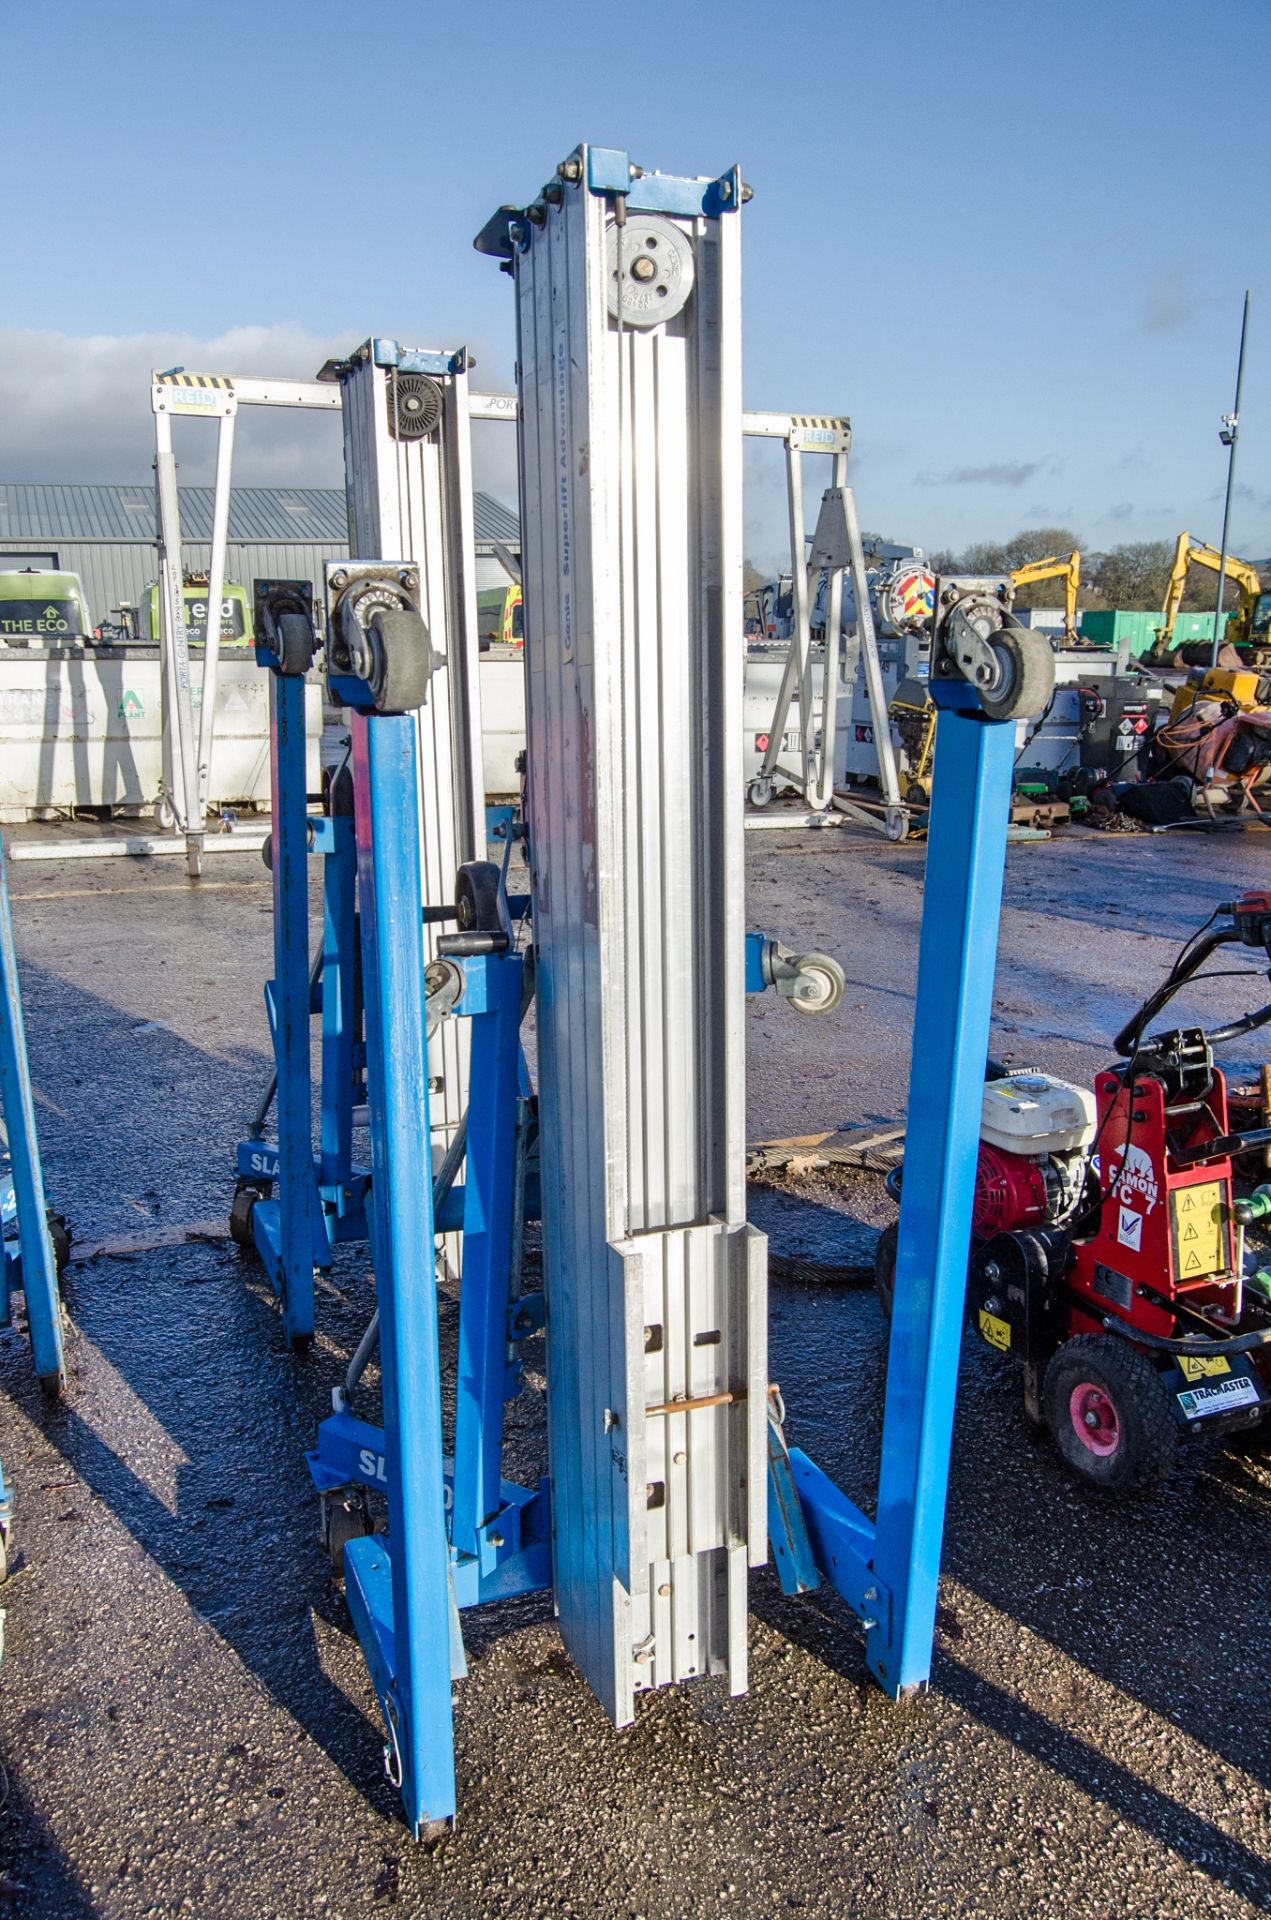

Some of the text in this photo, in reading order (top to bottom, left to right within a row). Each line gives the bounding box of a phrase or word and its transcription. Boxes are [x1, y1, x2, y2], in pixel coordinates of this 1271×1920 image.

[173, 389, 214, 405] REID
[805, 430, 834, 443] REID
[559, 343, 572, 650] Genie Superlift Advantage
[2, 619, 68, 632] THE ECO
[1108, 1164, 1158, 1198] SAMON
[1144, 1194, 1157, 1215] 7
